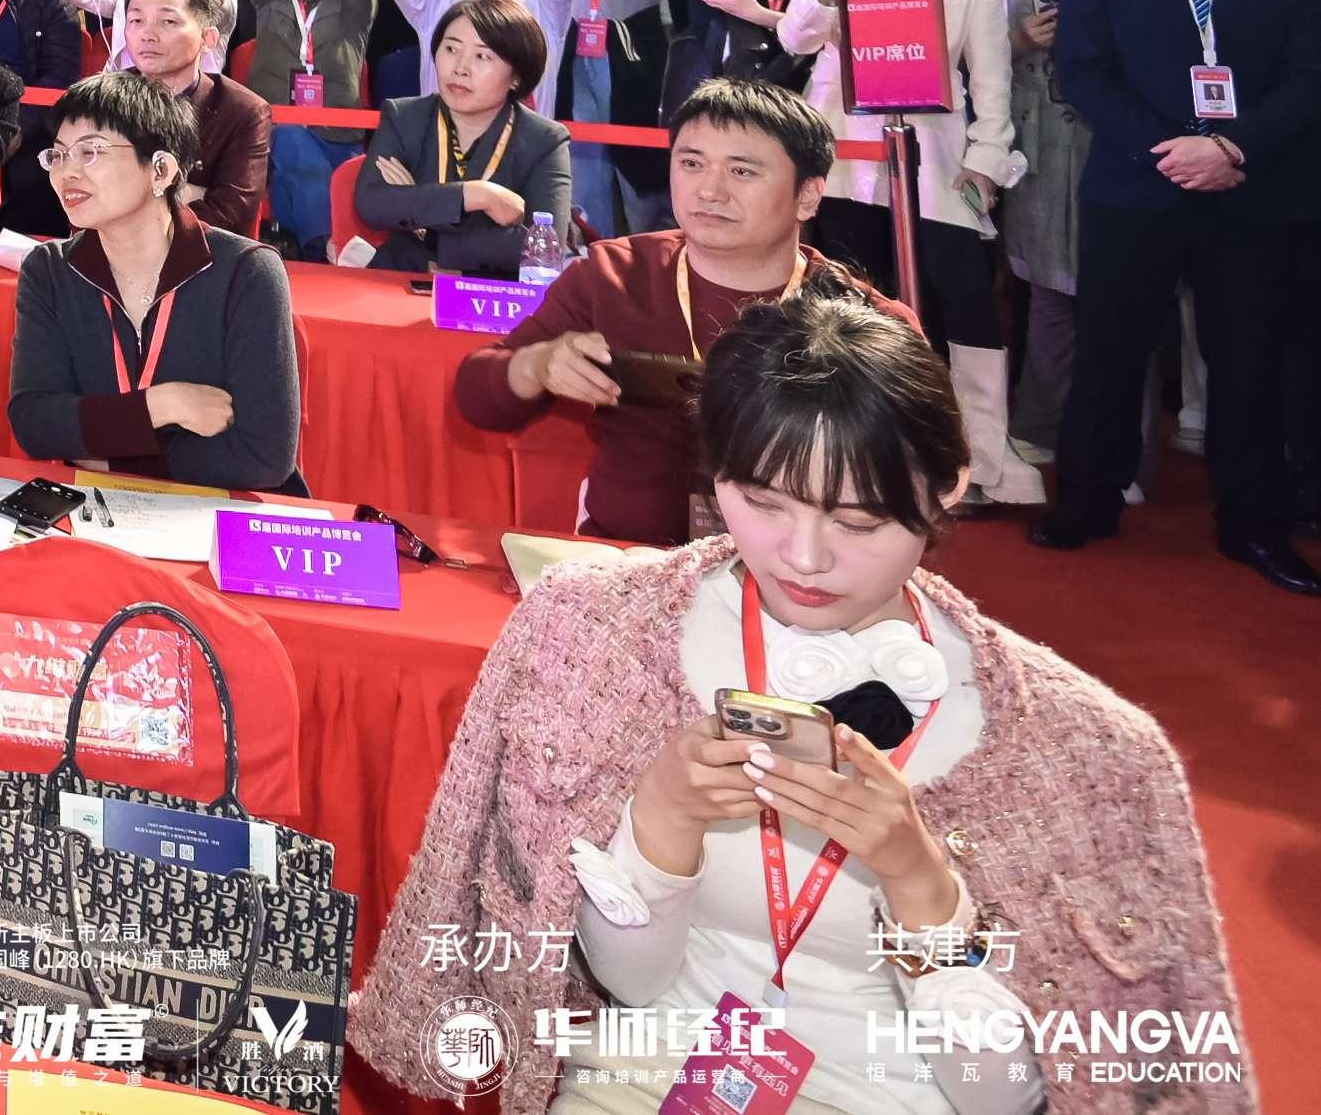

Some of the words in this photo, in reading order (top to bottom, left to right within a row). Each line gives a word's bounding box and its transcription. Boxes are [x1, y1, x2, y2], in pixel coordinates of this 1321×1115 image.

[851, 42, 927, 63] VIP席位
[470, 297, 522, 320] VIP
[271, 545, 343, 577] VIP
